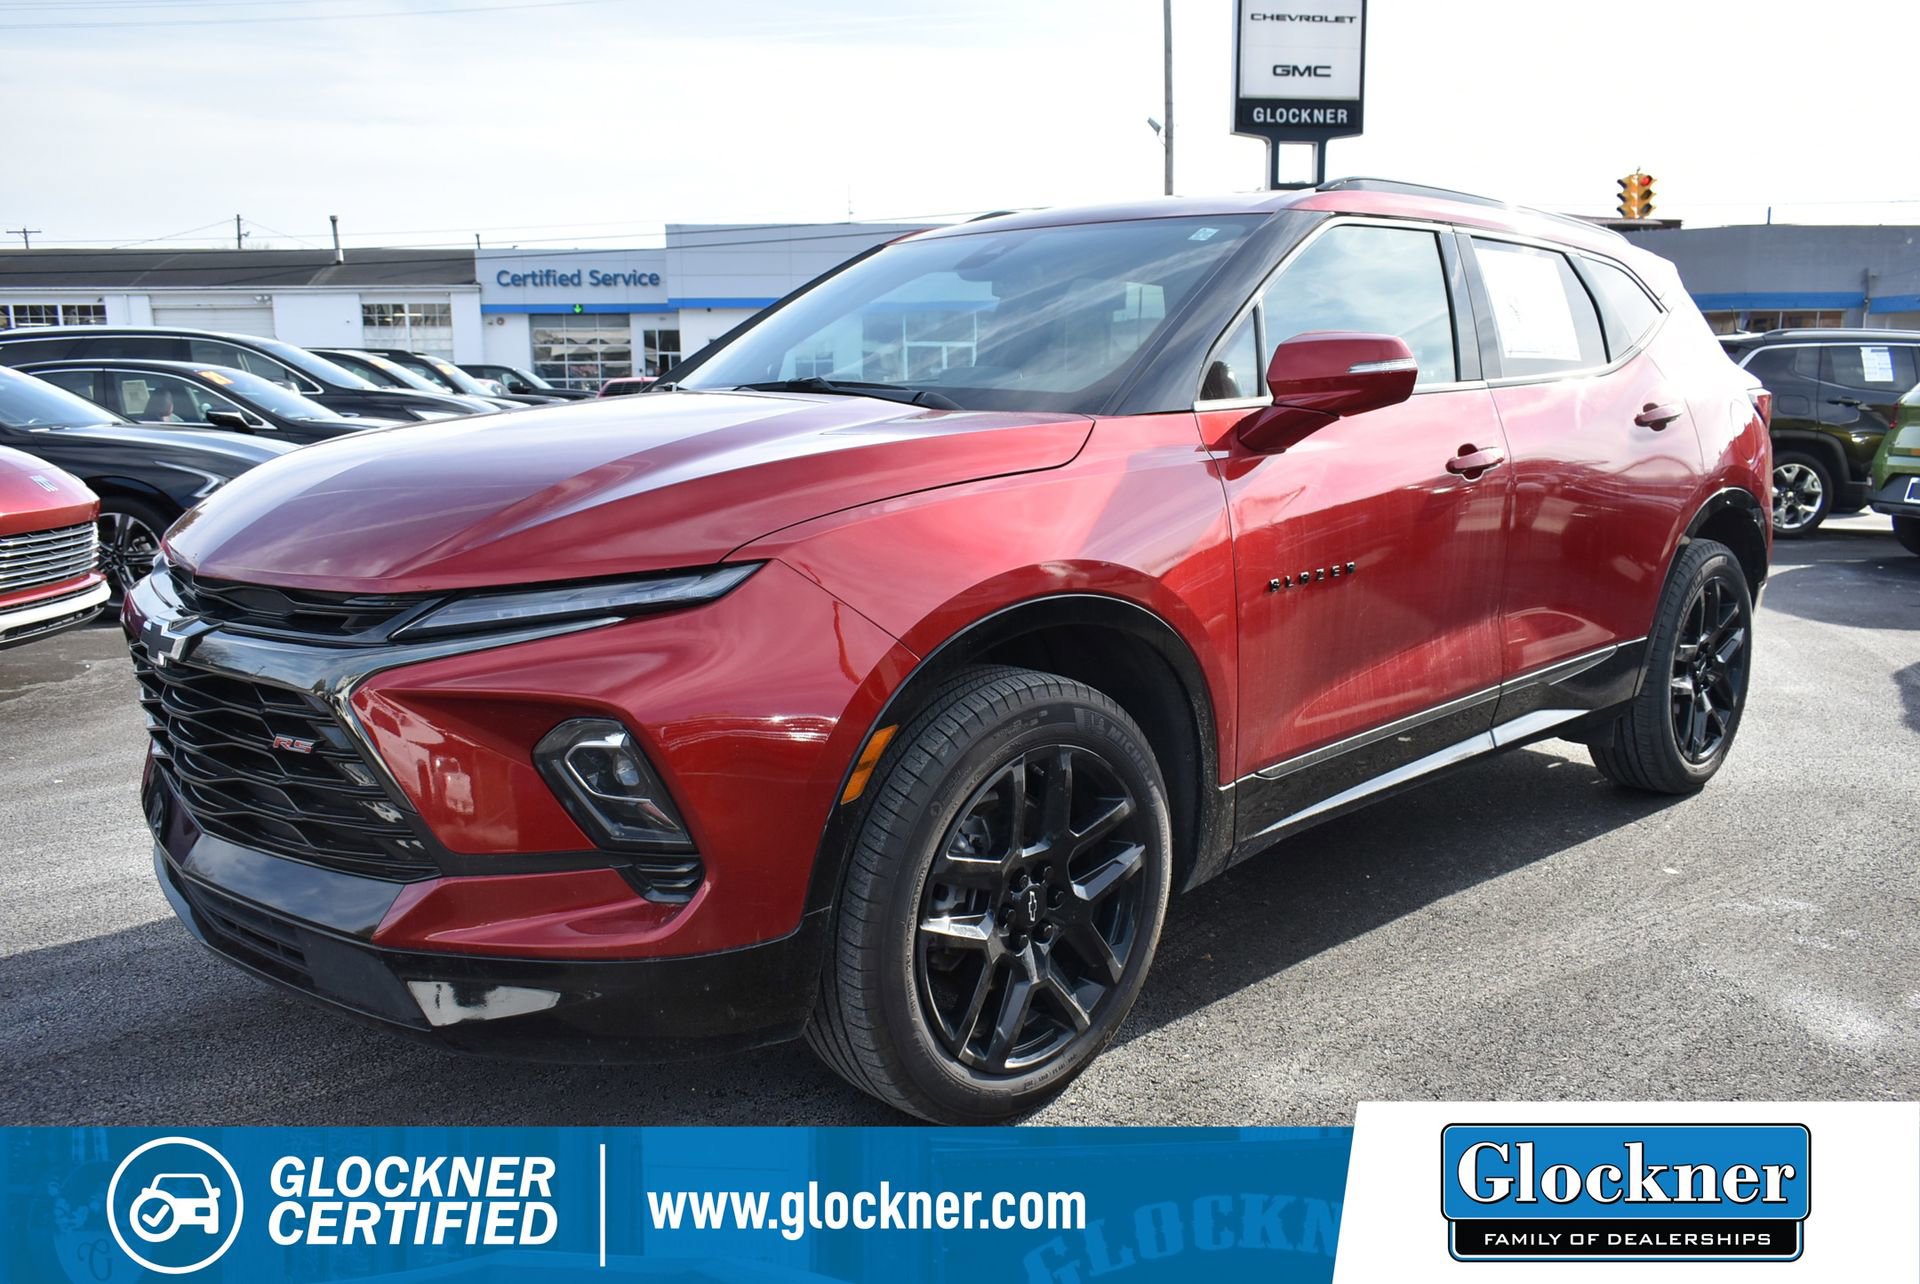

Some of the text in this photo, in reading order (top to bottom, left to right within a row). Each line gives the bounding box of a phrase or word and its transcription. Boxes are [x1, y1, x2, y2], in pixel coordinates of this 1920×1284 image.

[1250, 13, 1357, 24] CHEVROLET
[1272, 64, 1332, 78] GMC
[1252, 107, 1348, 124] GLOCKNER
[496, 268, 661, 288] Certified Service
[1268, 561, 1355, 593] BLAZER
[272, 734, 314, 754] RS
